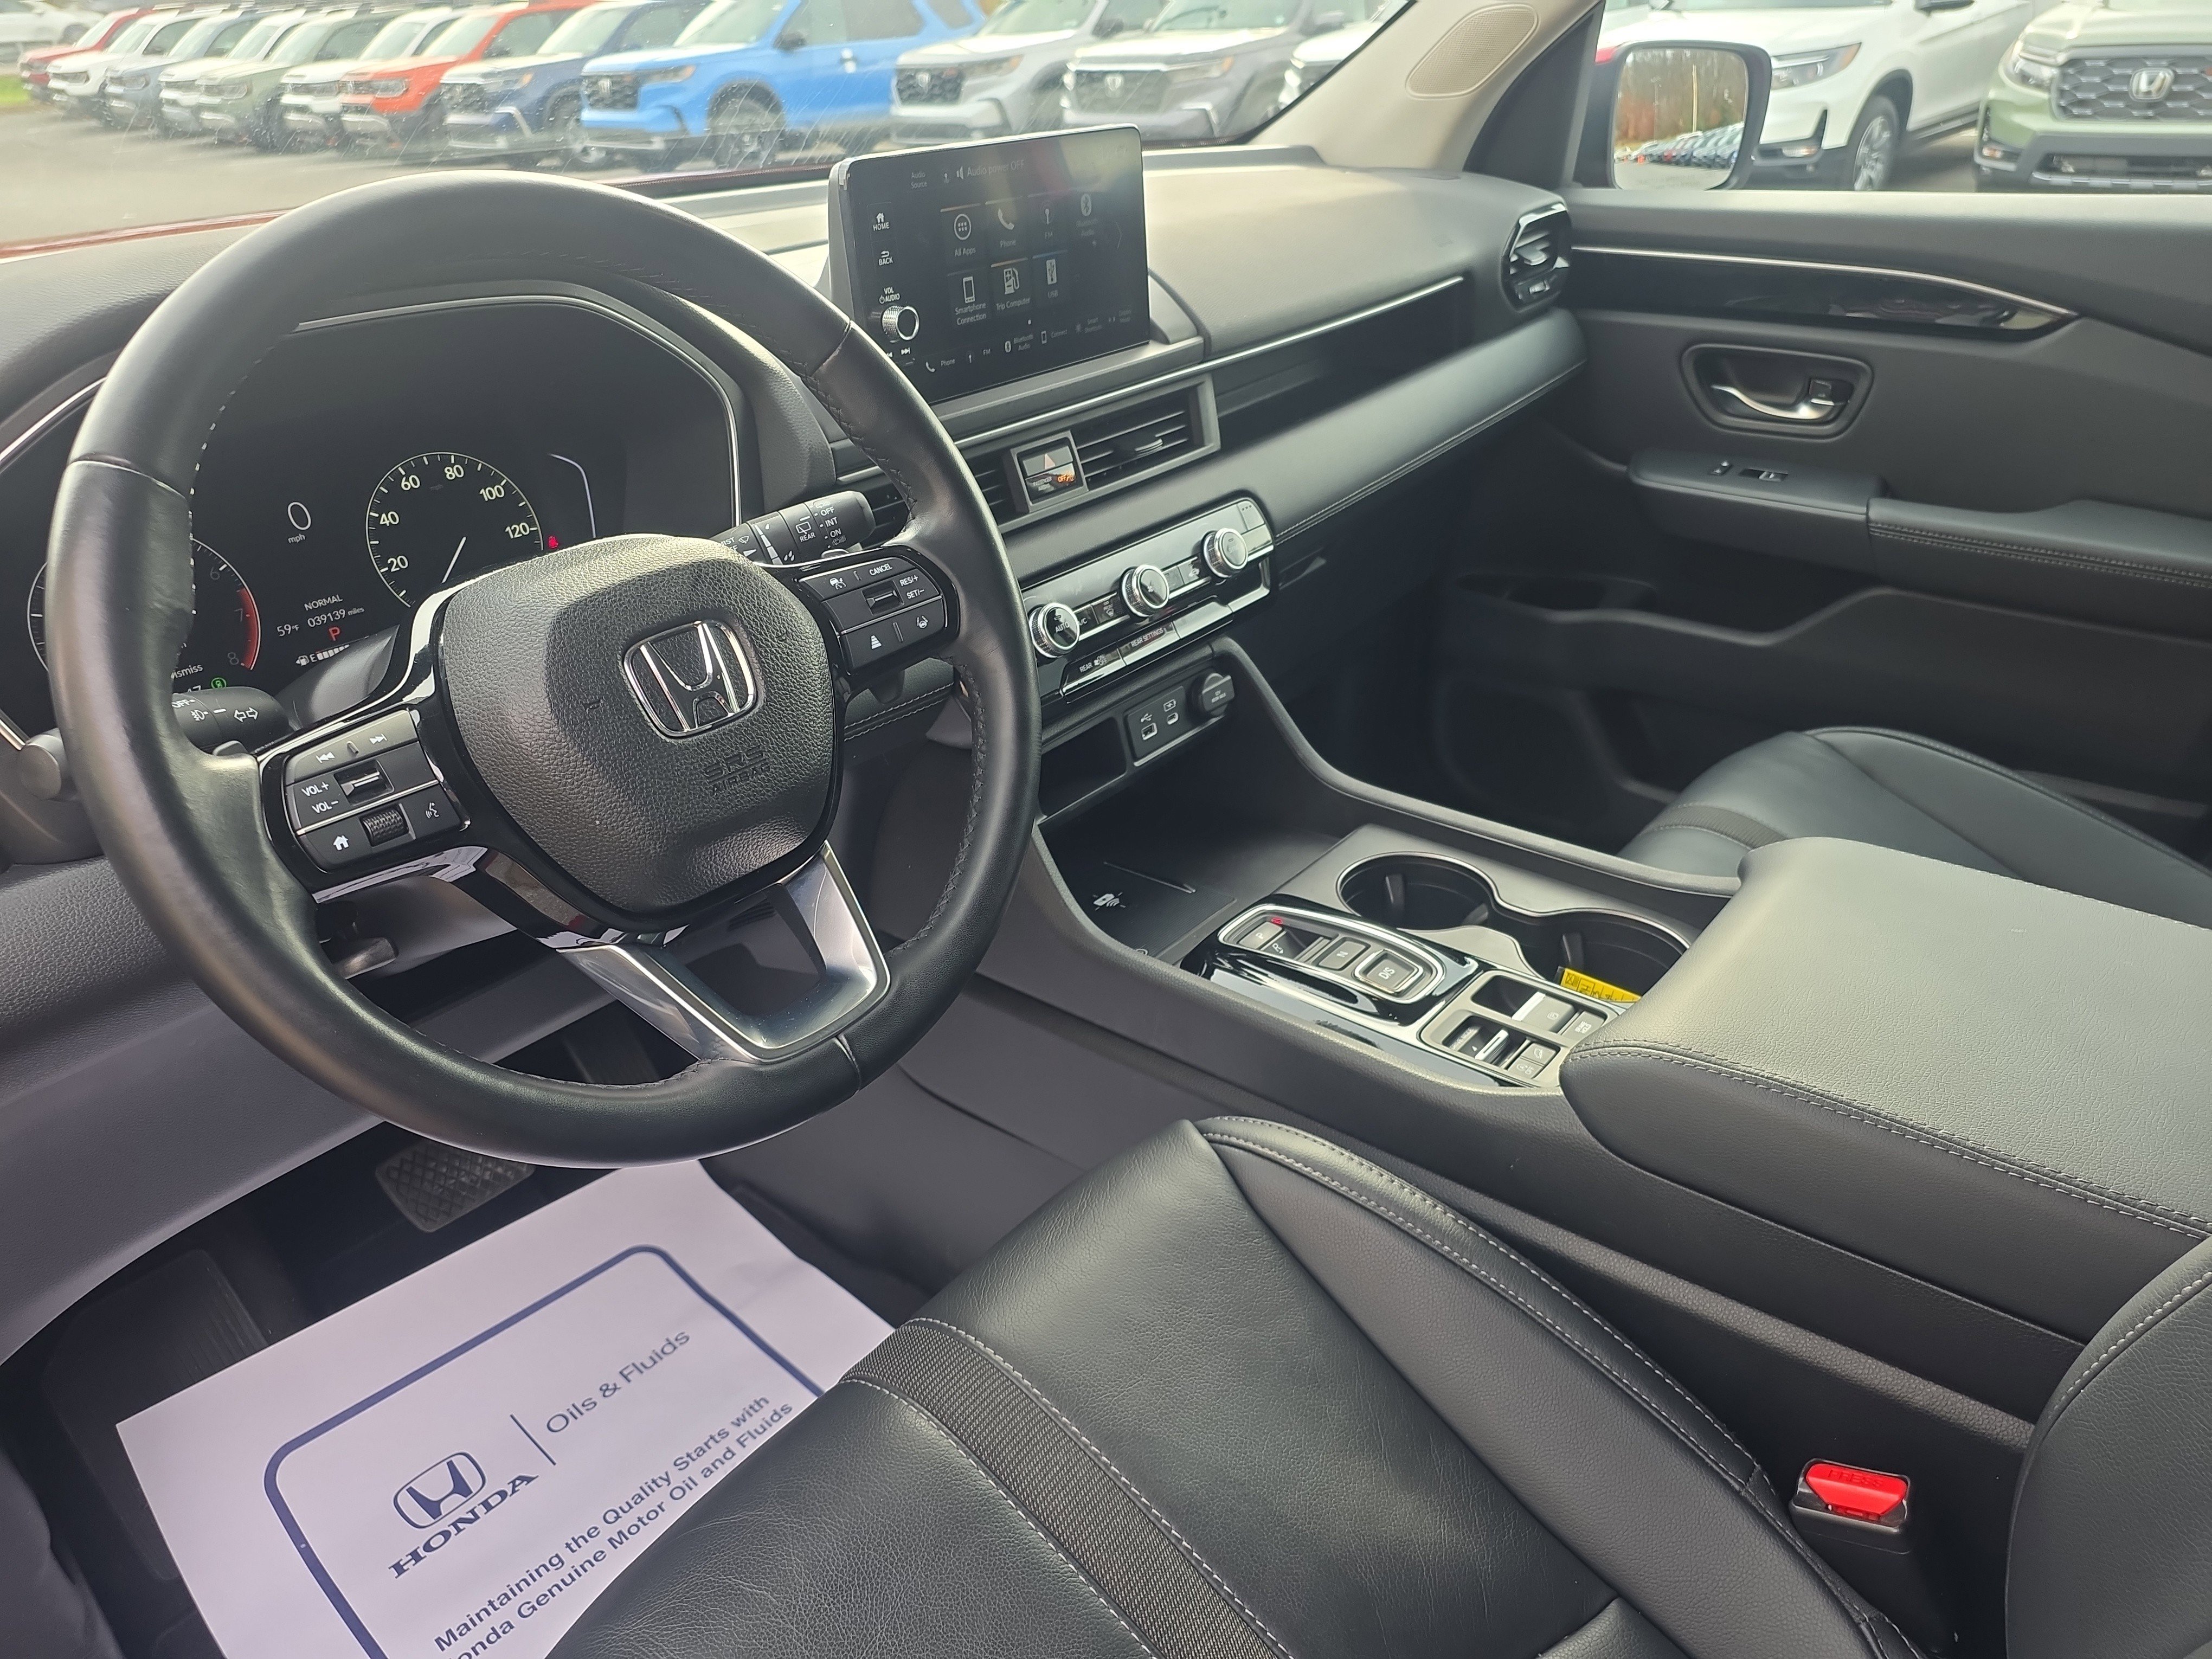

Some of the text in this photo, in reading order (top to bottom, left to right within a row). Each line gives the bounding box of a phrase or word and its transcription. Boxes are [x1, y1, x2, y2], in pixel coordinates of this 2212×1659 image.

[967, 159, 1024, 177] Audio power OFF
[911, 181, 928, 189] Source
[873, 222, 890, 231] HOME
[1000, 239, 1016, 248] Phone
[962, 247, 976, 256] Apps
[878, 257, 893, 266] BACK
[884, 287, 894, 295] VOL
[885, 293, 900, 302] AUDIO
[1048, 290, 1058, 299] USB
[955, 302, 986, 315] Smartphone
[996, 298, 1031, 311] Trip Computer
[957, 313, 987, 325] Connection
[941, 358, 955, 367] Phone
[444, 464, 464, 480] 80
[400, 474, 420, 492] 60
[479, 485, 505, 501] 100
[287, 501, 311, 530] 0
[820, 506, 834, 516] OFF
[380, 511, 400, 526] 40
[825, 517, 838, 527] INT
[505, 522, 530, 539] 120
[800, 532, 815, 542] REAR
[830, 528, 841, 537] ON
[288, 533, 306, 544] mph
[388, 556, 409, 572] 20
[869, 563, 892, 576] CANCEL
[210, 567, 220, 580] 6
[899, 575, 919, 587] RES/+
[304, 594, 343, 611] NORMAL
[234, 608, 243, 622] 7
[307, 609, 345, 627] 039139
[348, 607, 364, 615] miles
[329, 627, 340, 641] P
[1055, 622, 1070, 633] AUTO
[1131, 627, 1164, 647] REAR SETTINGS
[228, 652, 239, 665] 8
[309, 654, 317, 663] E
[1079, 663, 1093, 673] REAR
[1272, 943, 1282, 952] R
[1379, 967, 1395, 980] D/S
[546, 1331, 691, 1433] Oils & Fluids
[1828, 1469, 1883, 1487] PRESS
[388, 1474, 539, 1579] HONDA
[434, 1396, 769, 1652] Maintaining the Quality Starts with
[448, 1404, 793, 1659] onda Genuine Motor Oil and Fluids
